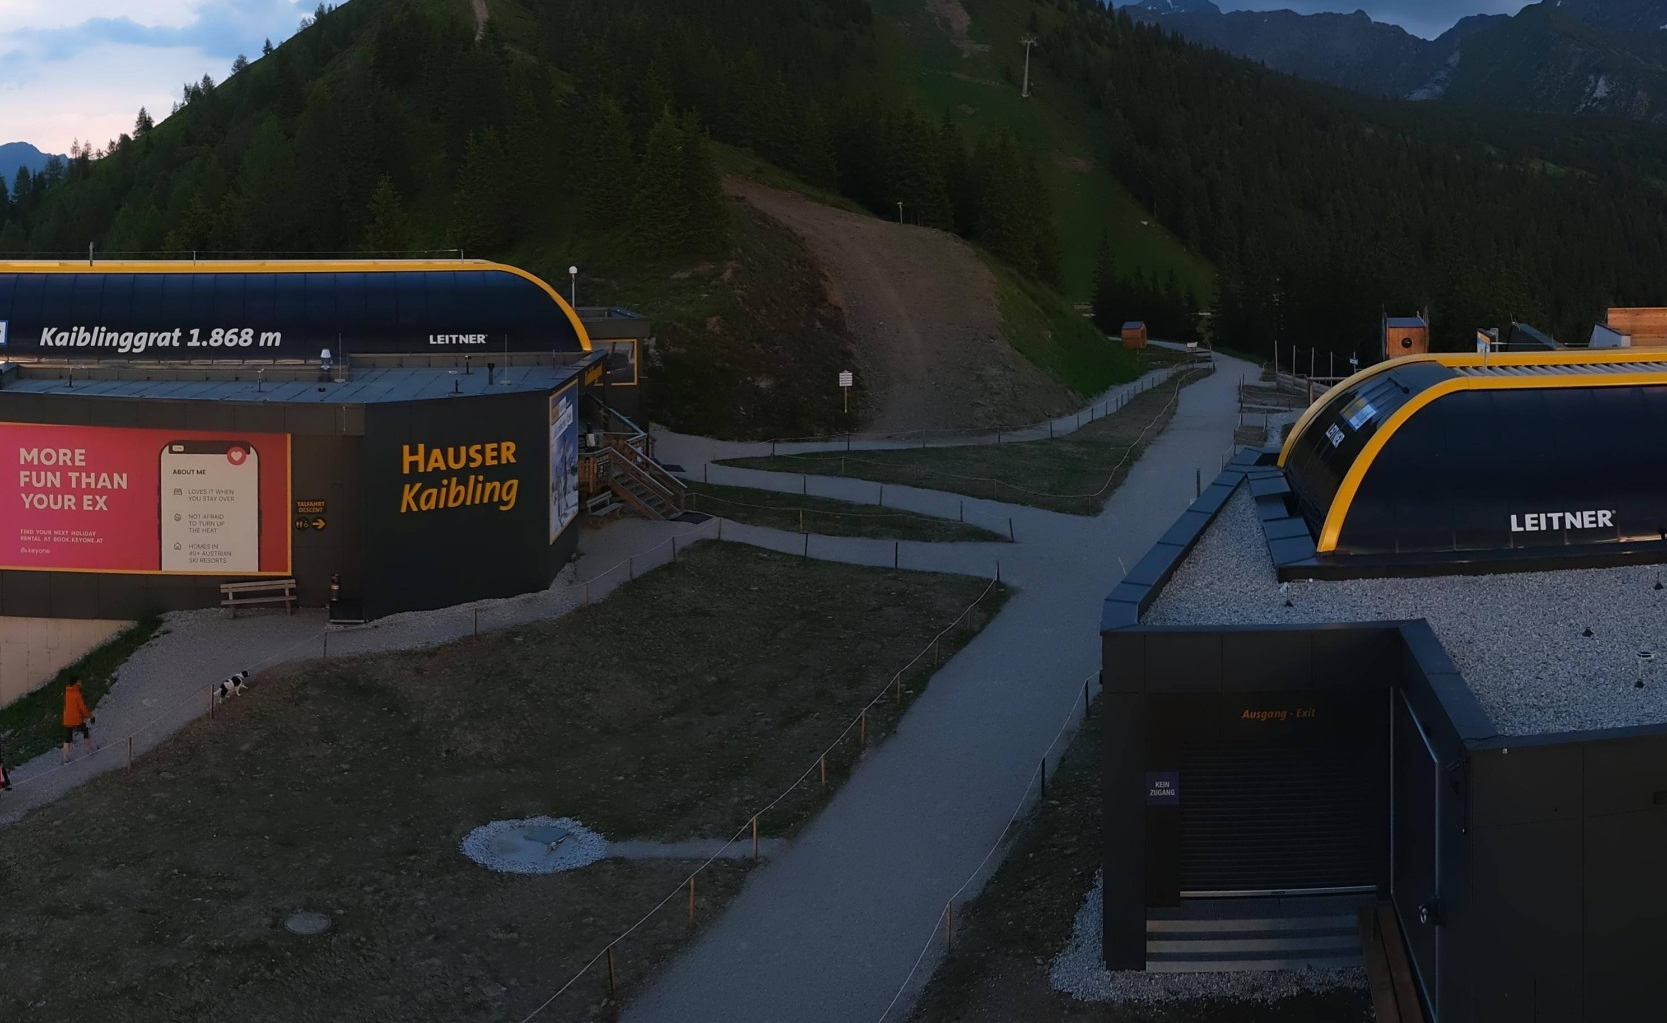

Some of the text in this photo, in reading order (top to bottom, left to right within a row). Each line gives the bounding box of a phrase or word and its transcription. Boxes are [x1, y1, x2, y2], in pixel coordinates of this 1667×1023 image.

[40, 326, 281, 354] Kaiblinggrat 1.868 m
[429, 334, 487, 345] LEITNER
[20, 448, 86, 466] MORE
[402, 441, 517, 475] HAUSER
[20, 471, 128, 489] FUN THAN
[20, 493, 108, 511] YOUR EX
[400, 475, 520, 513] Kaibling
[1510, 509, 1614, 532] LEITNER
[28, 547, 50, 556] keyone
[1241, 708, 1288, 720] Ausgang
[1296, 707, 1316, 718] Exit
